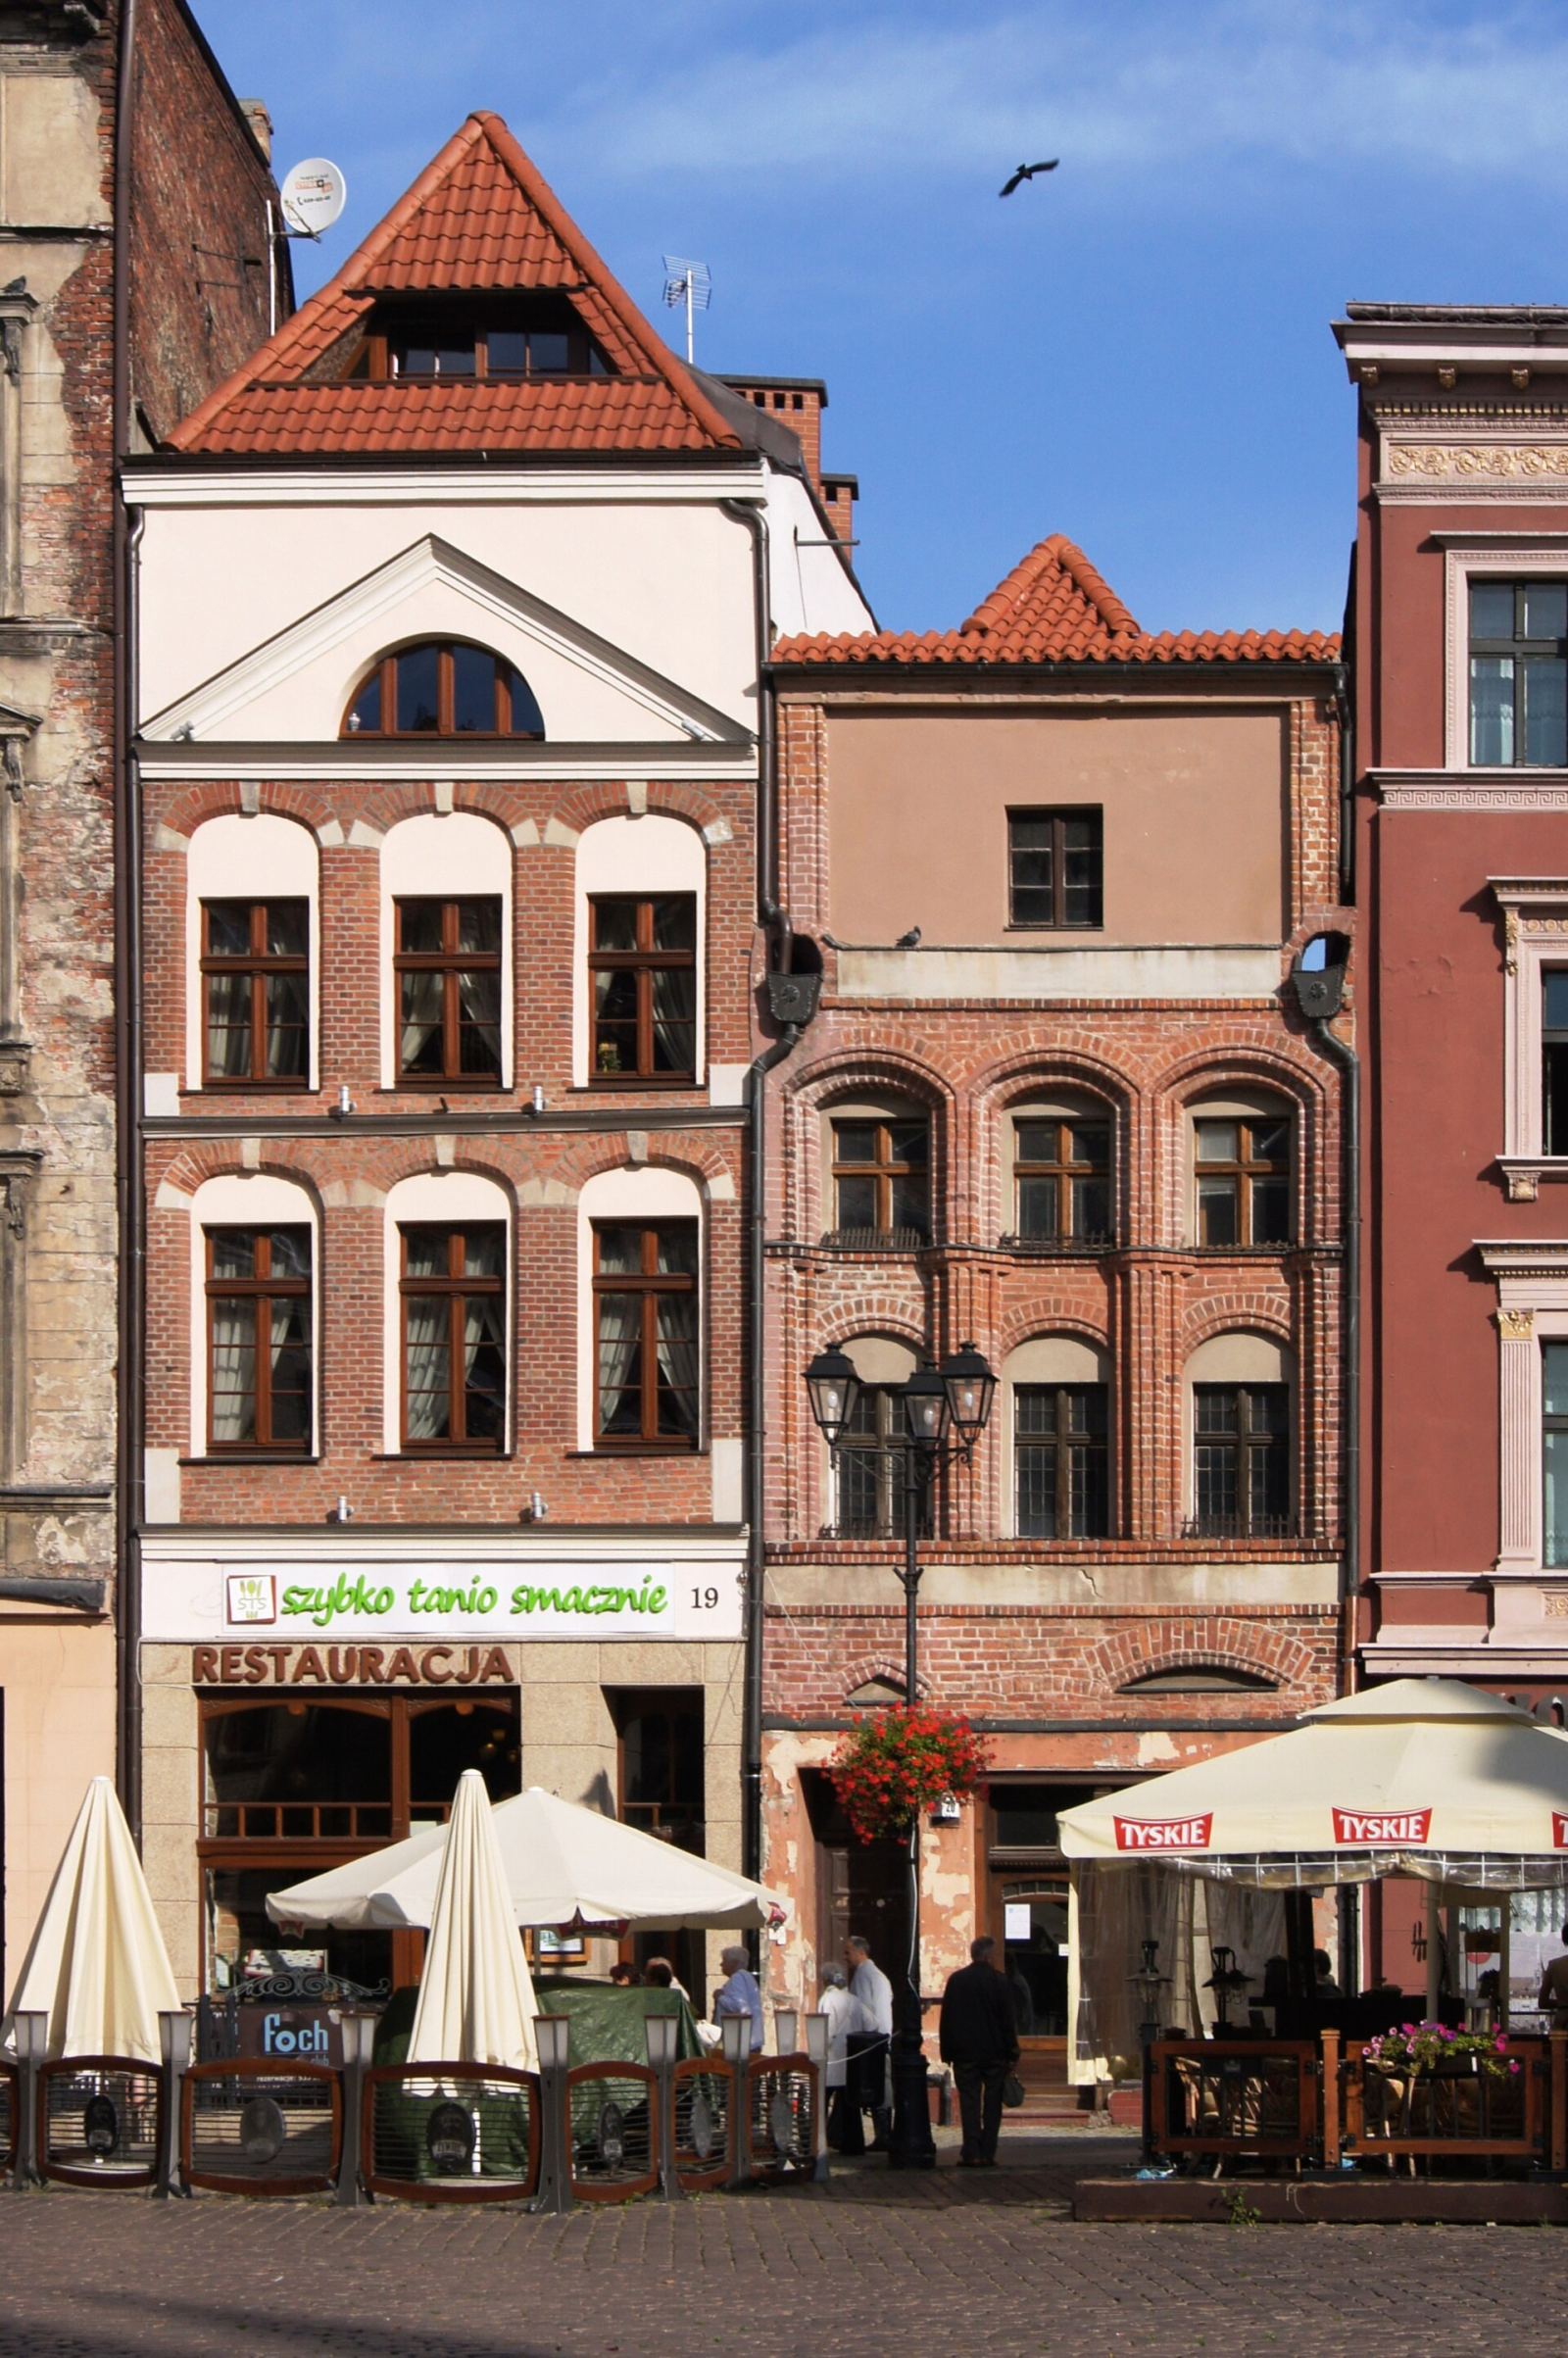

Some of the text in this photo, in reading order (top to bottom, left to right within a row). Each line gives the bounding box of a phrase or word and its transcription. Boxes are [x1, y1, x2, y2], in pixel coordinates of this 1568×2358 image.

[237, 1597, 267, 1610] STS
[281, 1572, 668, 1626] szybko tanio smacznie
[691, 1587, 719, 1609] 19
[192, 1646, 514, 1684] RESTAURACJA
[1120, 1819, 1205, 1846] TYSKIE
[1339, 1815, 1424, 1841] TYSKIE
[264, 2013, 328, 2052] foch
